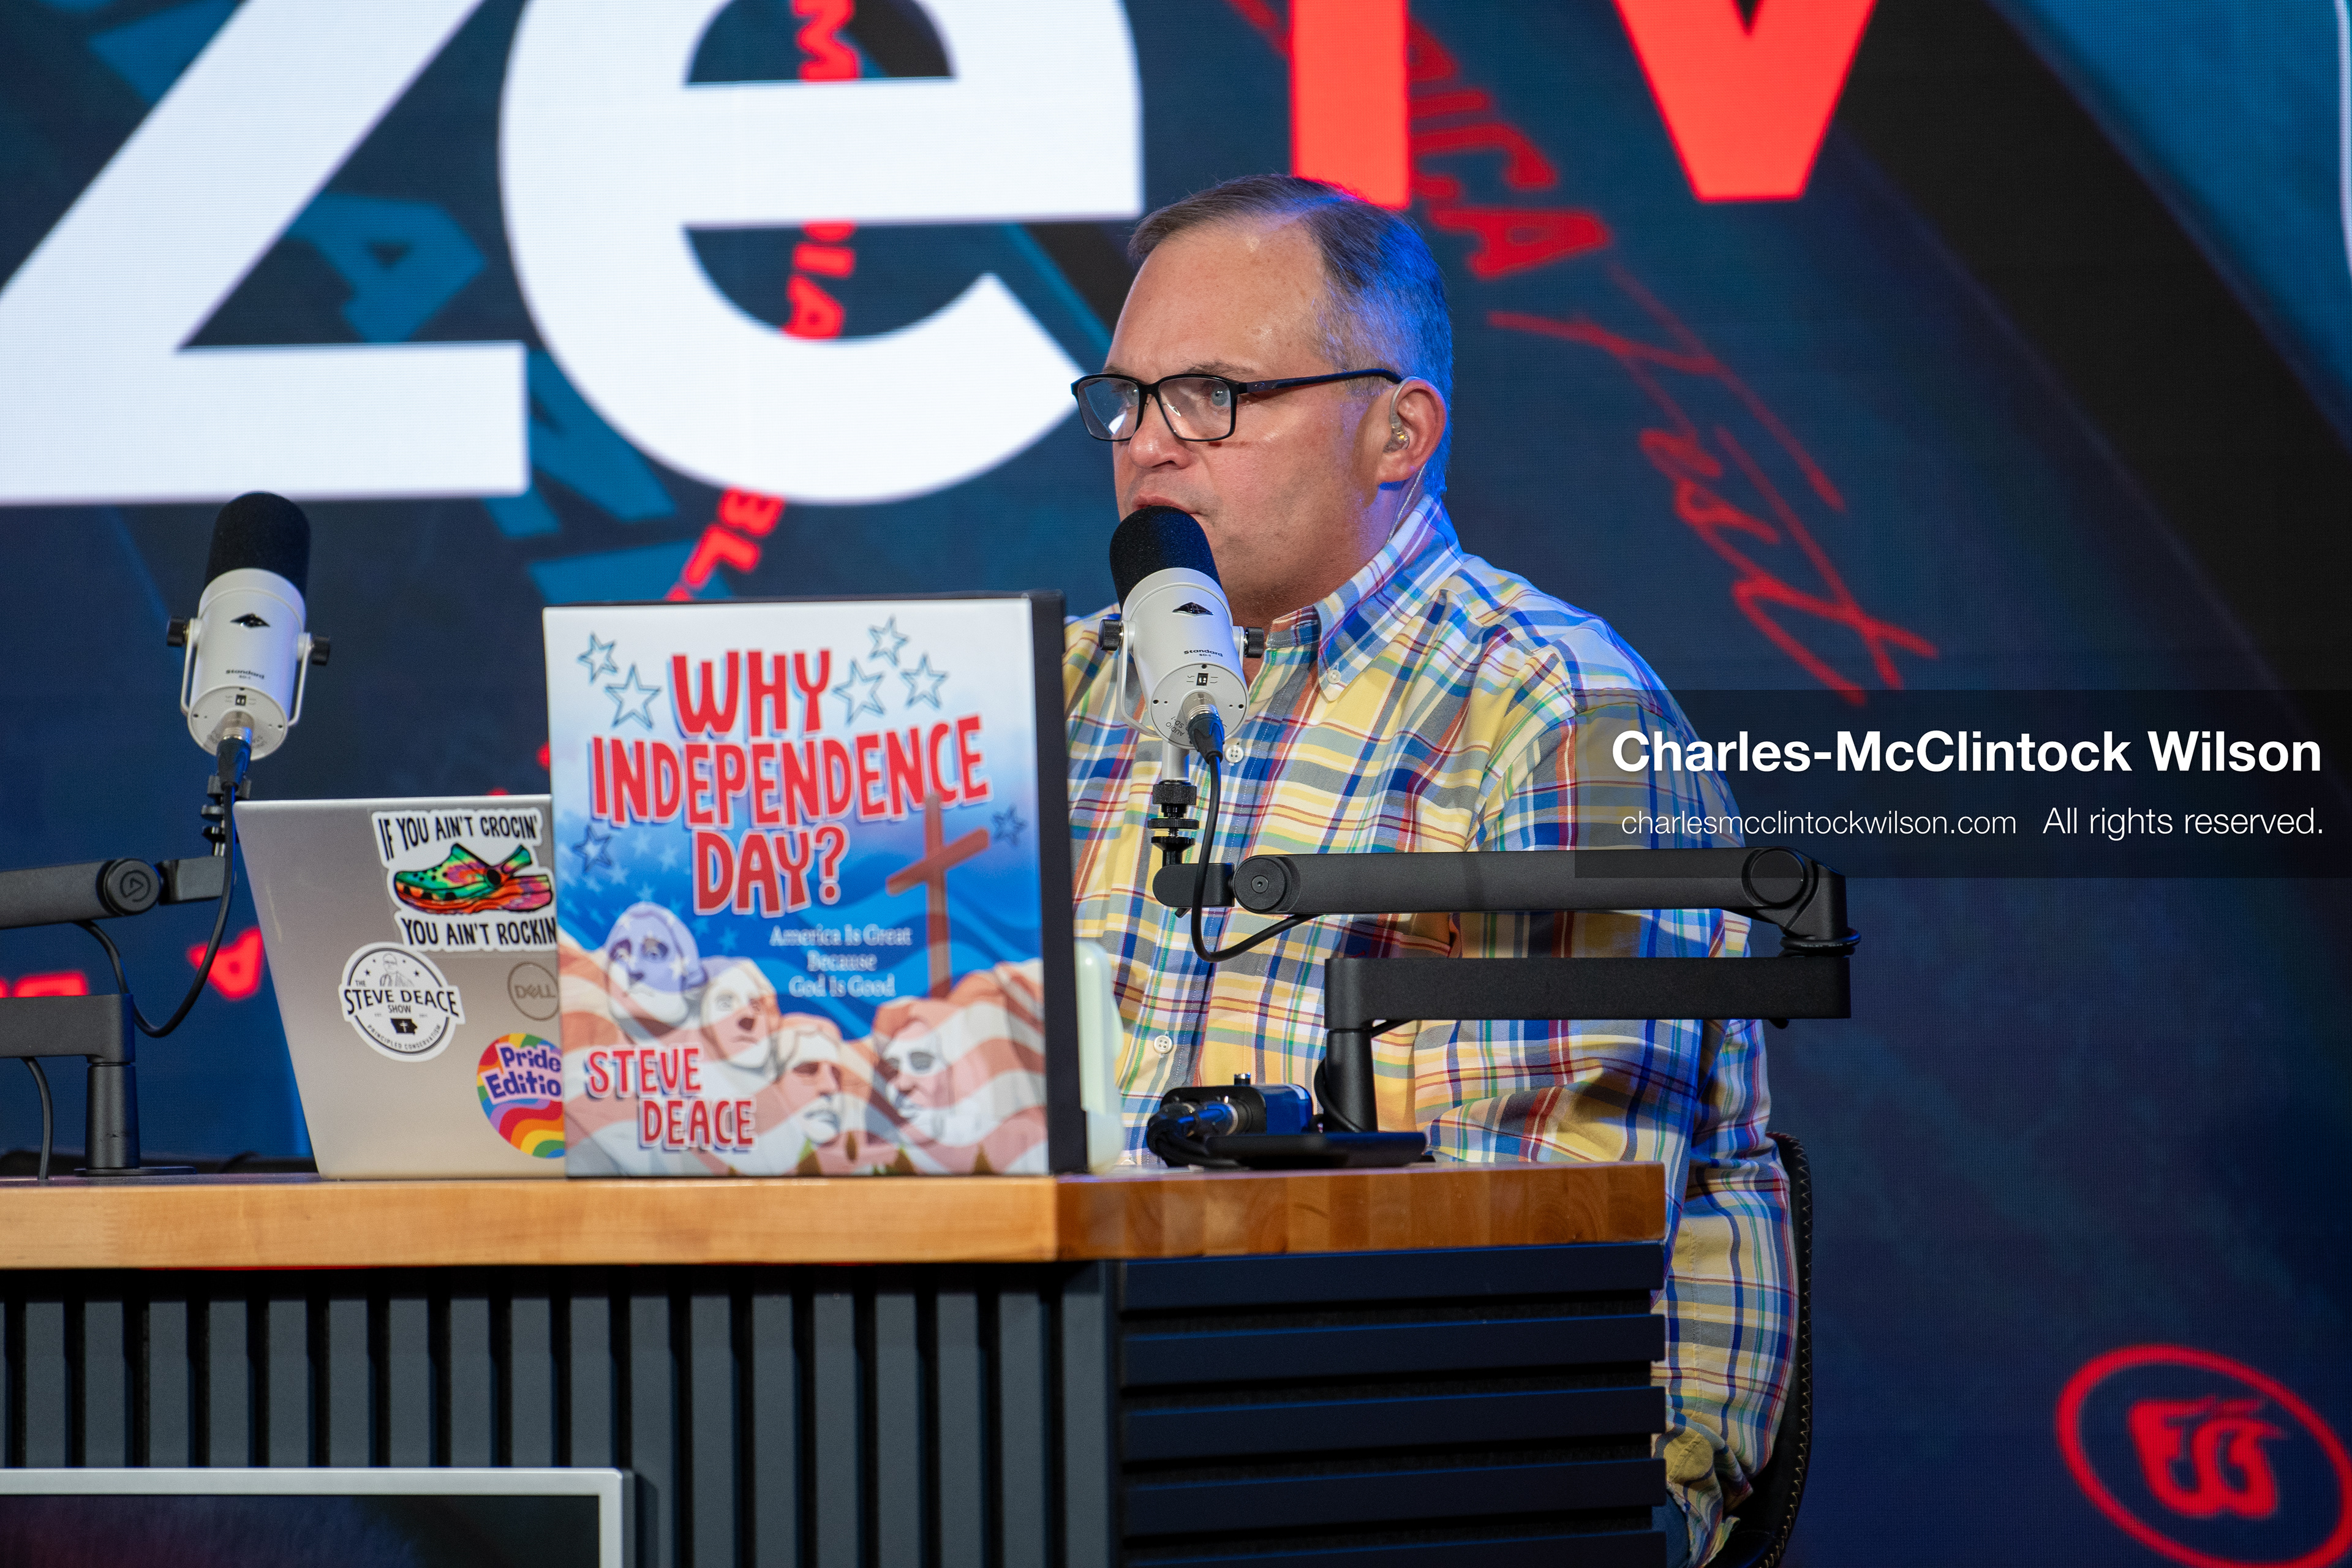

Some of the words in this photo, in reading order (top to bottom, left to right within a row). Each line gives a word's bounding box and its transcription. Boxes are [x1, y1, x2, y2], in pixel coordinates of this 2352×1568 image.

[668, 647, 833, 739] WHY
[1166, 722, 1185, 737] AUDIO
[589, 714, 992, 827] INDEPENDENCE
[379, 818, 394, 861] IF
[396, 817, 429, 851] YOU
[435, 815, 474, 841] AIN'T
[480, 815, 538, 840] CROCIN'
[693, 823, 849, 916] DAY?
[399, 918, 439, 945] YOU
[447, 922, 490, 945] AIN'T
[769, 923, 843, 946] America
[843, 924, 862, 946] Is
[862, 923, 913, 946] Great
[807, 949, 878, 972] Because
[514, 984, 556, 999] DELL
[788, 973, 827, 998] God
[829, 975, 846, 998] Is
[846, 973, 896, 998] Good
[344, 989, 395, 1016] STEVE
[401, 990, 459, 1017] DEACE
[388, 1005, 412, 1014] SHOW
[368, 1024, 402, 1049] PRINCIPLED
[499, 1047, 562, 1072] Pride
[586, 1046, 703, 1096] STEVE
[639, 1098, 756, 1149] DEACE
